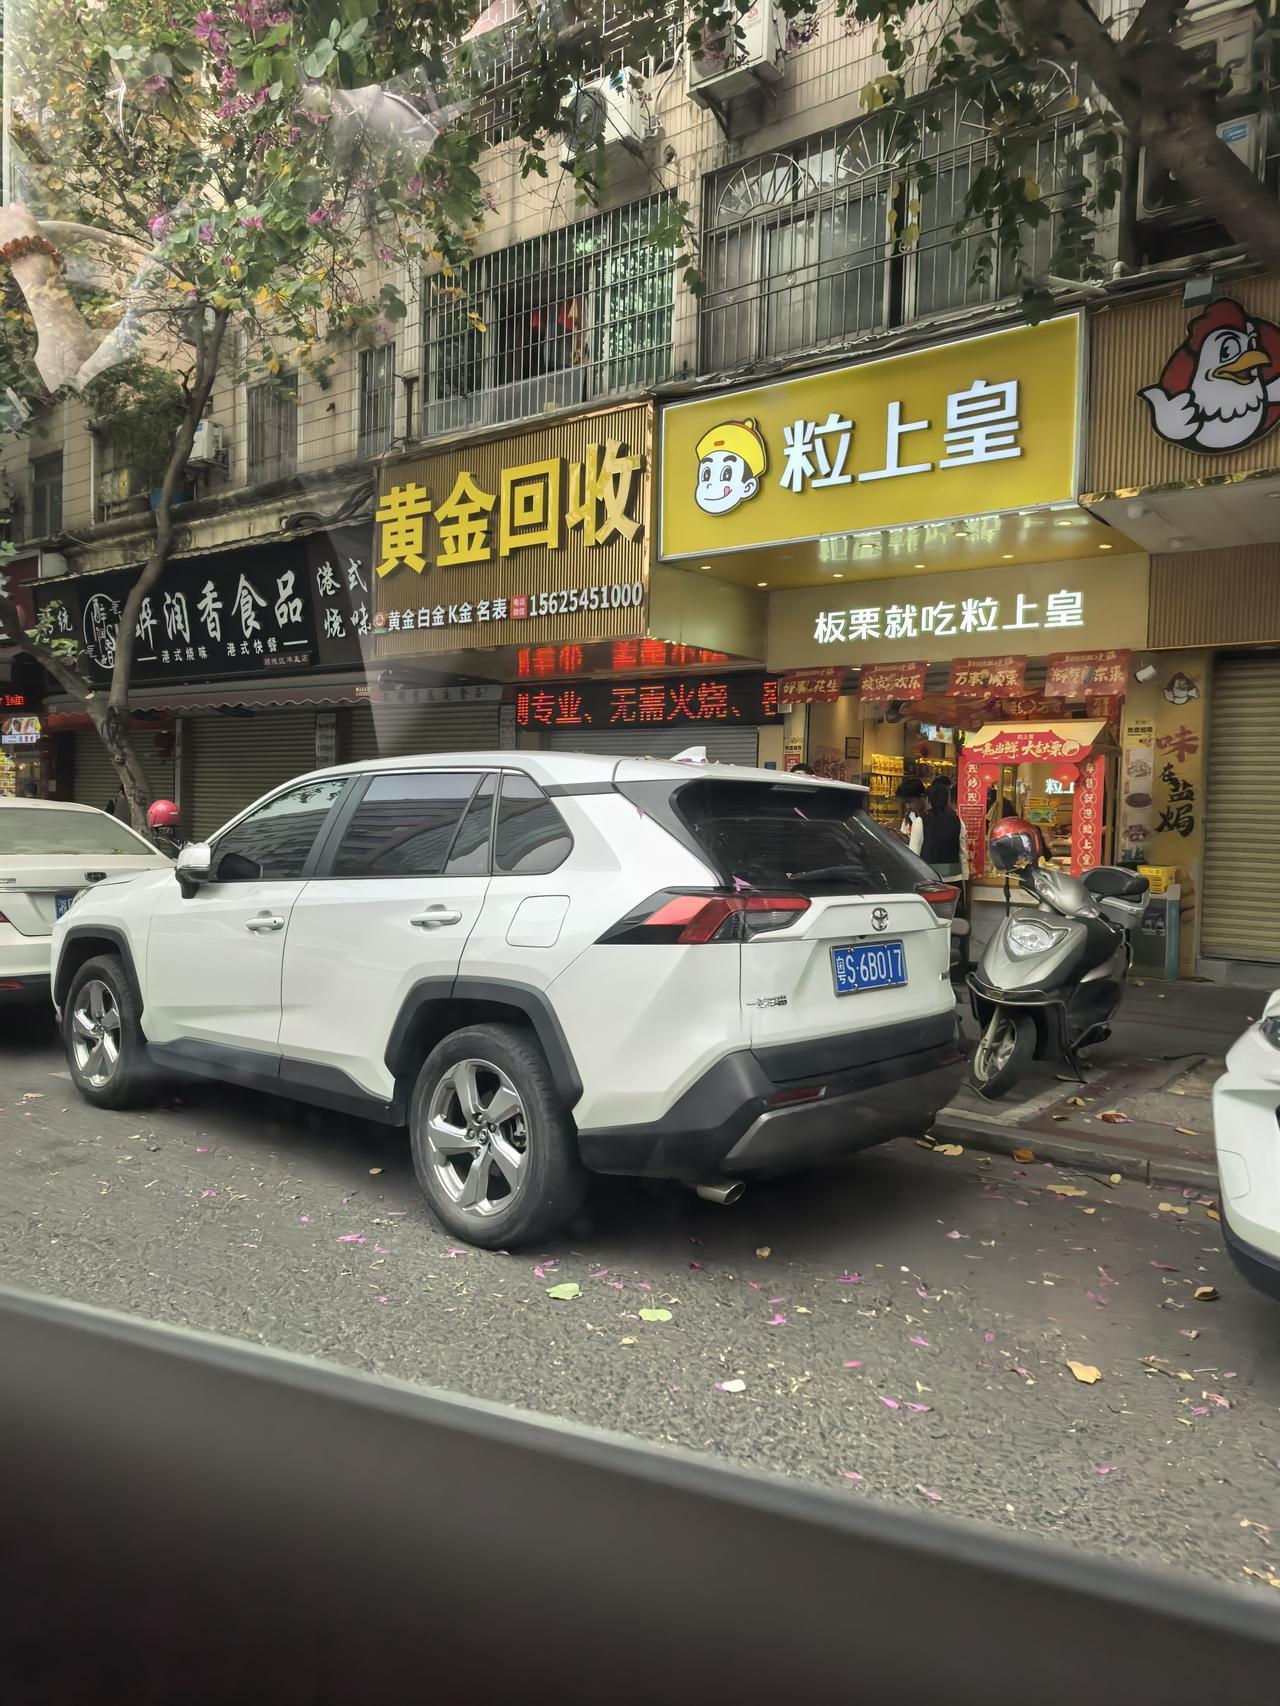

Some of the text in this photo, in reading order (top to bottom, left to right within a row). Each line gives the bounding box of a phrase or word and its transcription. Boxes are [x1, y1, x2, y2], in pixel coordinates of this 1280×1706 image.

[779, 380, 1022, 493] 粒上皇
[376, 438, 643, 578] 黄金回收
[316, 557, 368, 597] 港式
[529, 581, 643, 617] 15625451000
[813, 589, 1085, 644] 板栗就吃粒上皇
[324, 601, 372, 639] 烧味
[226, 637, 278, 657] 港式快餐
